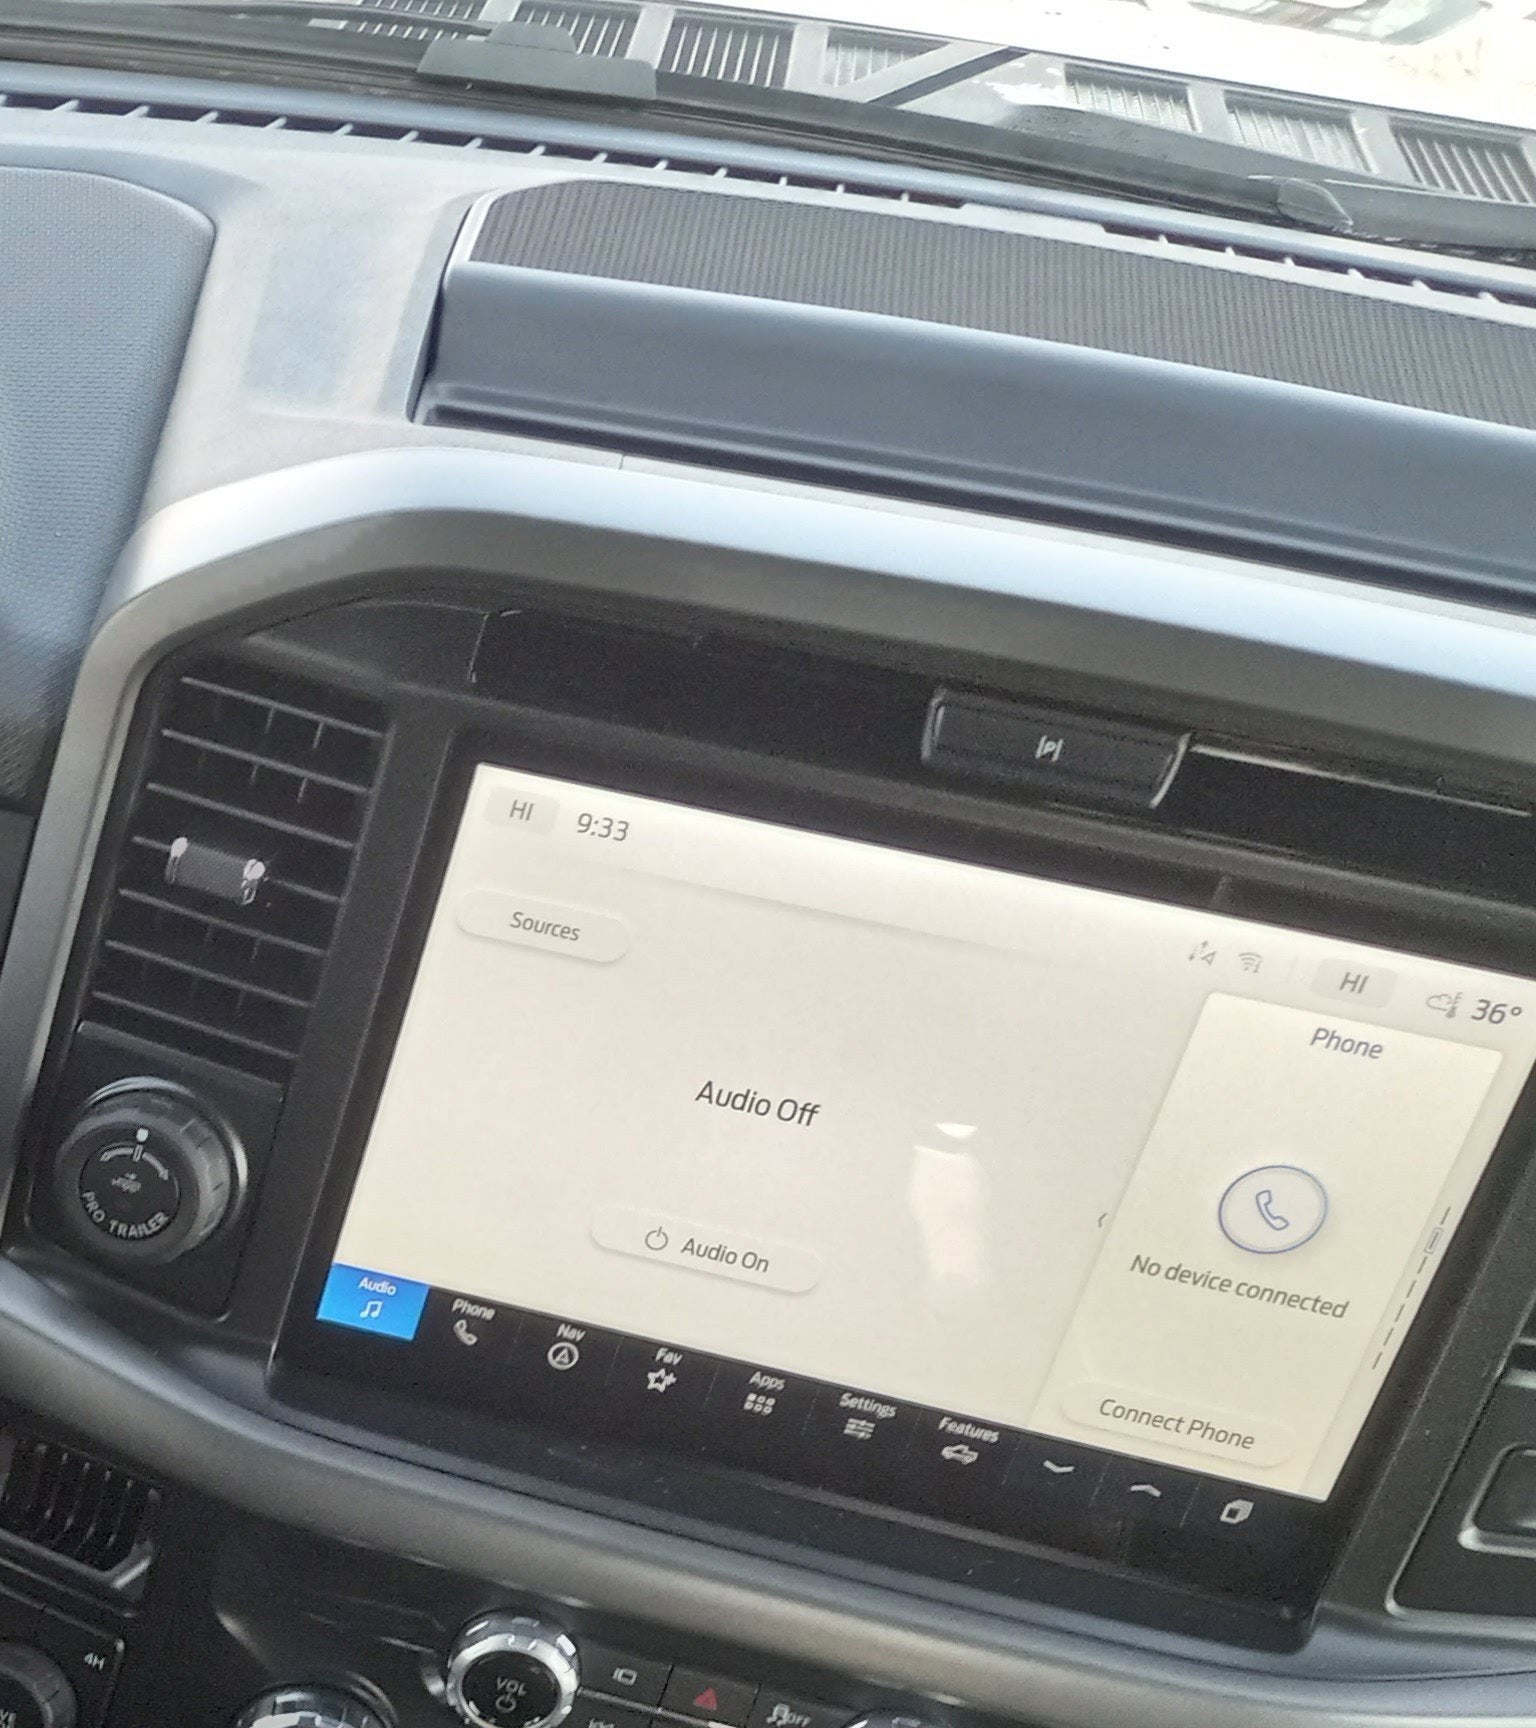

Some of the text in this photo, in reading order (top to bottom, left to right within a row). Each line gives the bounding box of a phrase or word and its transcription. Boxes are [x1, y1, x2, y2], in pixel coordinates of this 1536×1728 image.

[509, 799, 533, 822] HI
[576, 812, 630, 842] 9:33
[509, 911, 581, 942] Sources
[1339, 971, 1369, 994] HI
[1471, 997, 1522, 1025] 36°
[1310, 1027, 1384, 1060] Phone
[694, 1080, 822, 1127] Audio Off
[82, 1191, 170, 1239] PRO TRAILER
[680, 1238, 770, 1273] Audio On
[358, 1276, 397, 1296] Audio
[1130, 1254, 1349, 1319] No device connected
[451, 1298, 496, 1321] Phone
[556, 1322, 586, 1342] Nav
[655, 1347, 684, 1366] Fav
[748, 1370, 786, 1392] Apps
[838, 1392, 898, 1420] Settings
[938, 1416, 1001, 1444] Features
[1099, 1397, 1256, 1450] Connect Phone
[84, 1652, 105, 1670] 4H
[495, 1676, 529, 1697] VOL
